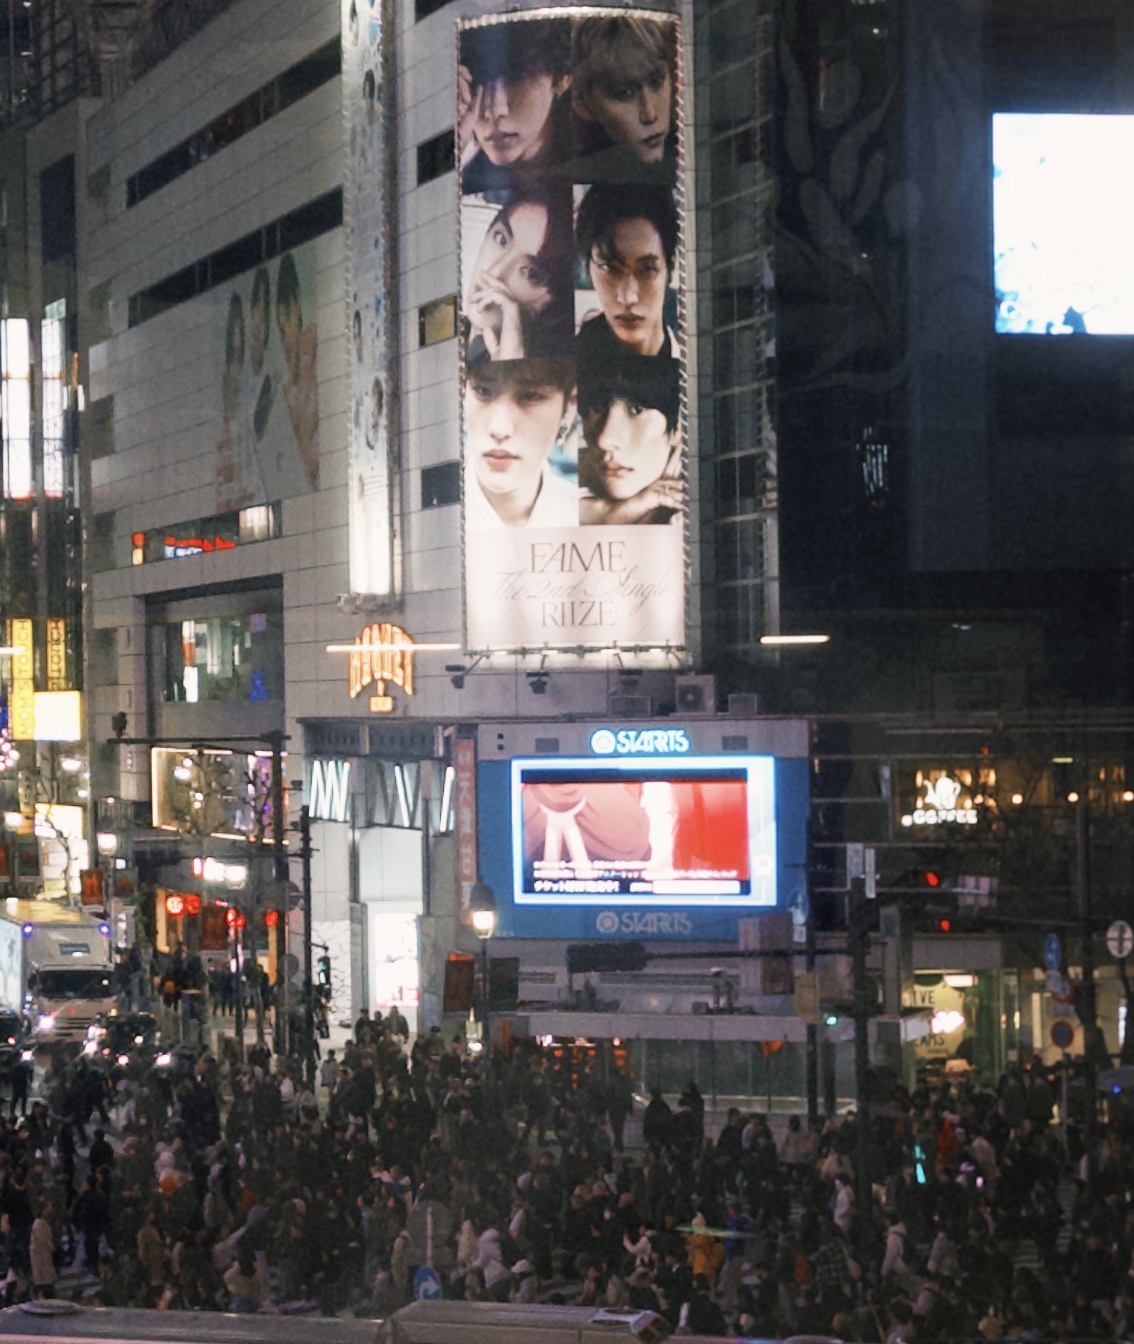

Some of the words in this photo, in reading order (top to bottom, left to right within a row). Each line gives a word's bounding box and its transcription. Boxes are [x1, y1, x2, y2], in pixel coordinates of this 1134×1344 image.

[530, 540, 627, 574] FAME
[541, 600, 616, 628] RIIZE
[17, 619, 32, 677] TOUCH
[616, 729, 690, 753] STARTS
